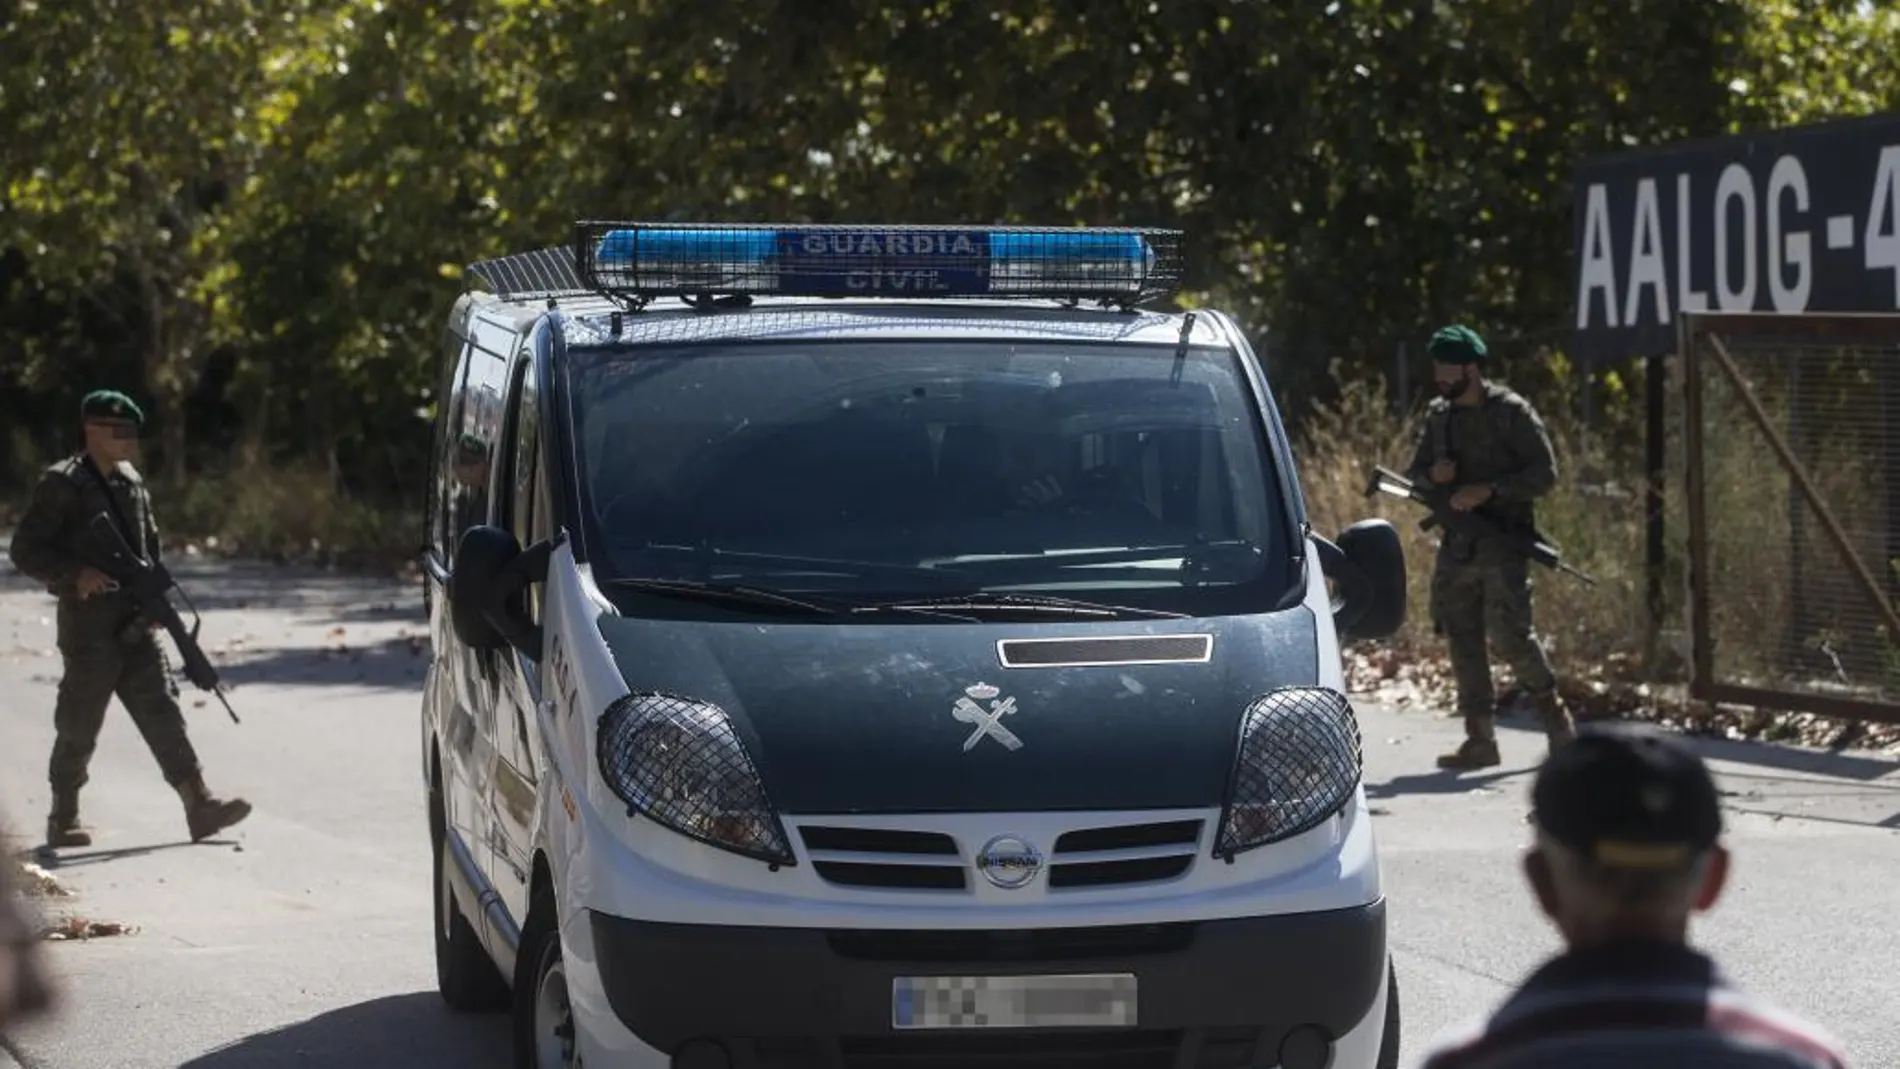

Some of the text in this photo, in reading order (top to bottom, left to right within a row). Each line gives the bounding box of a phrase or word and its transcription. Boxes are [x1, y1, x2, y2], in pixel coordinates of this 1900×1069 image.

[803, 234, 975, 253] GUARDIA
[846, 270, 949, 289] CIVIL
[982, 854, 1038, 868] NISSAN
